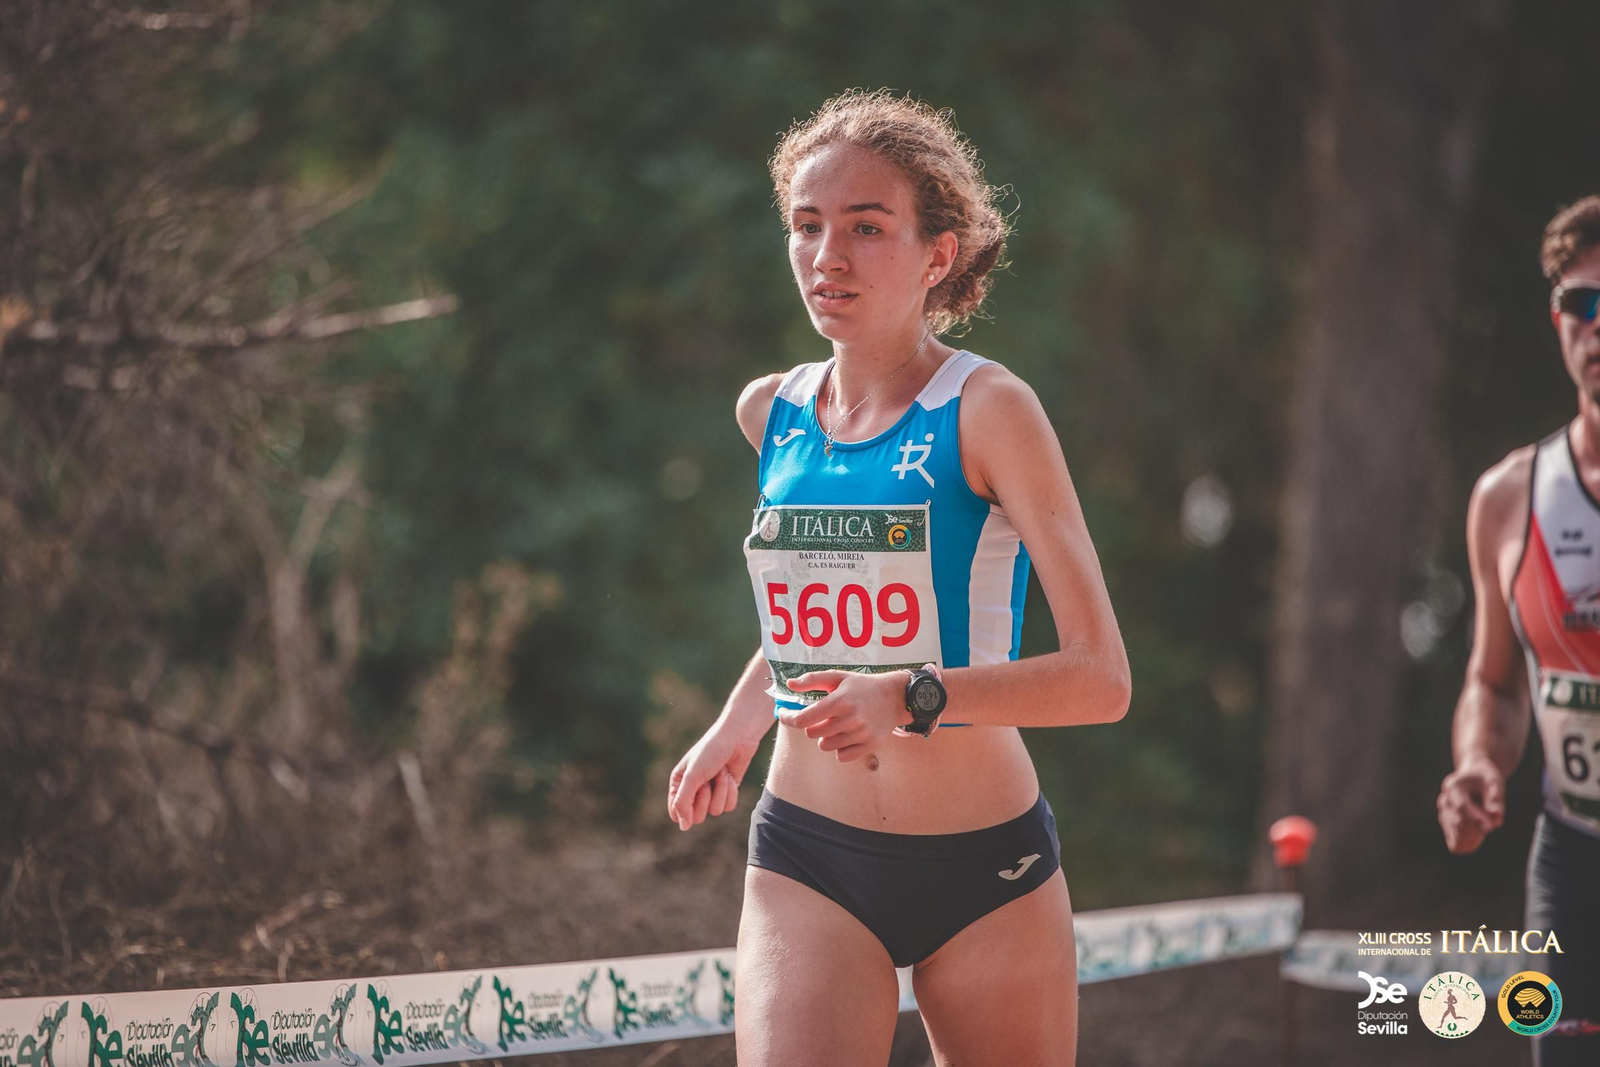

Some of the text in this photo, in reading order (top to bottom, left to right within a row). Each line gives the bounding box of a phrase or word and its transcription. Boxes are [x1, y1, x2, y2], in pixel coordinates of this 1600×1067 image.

[791, 511, 874, 537] ITÁLICA
[799, 551, 864, 561] BARCELÓ, MIREIA
[767, 582, 921, 648] 5609
